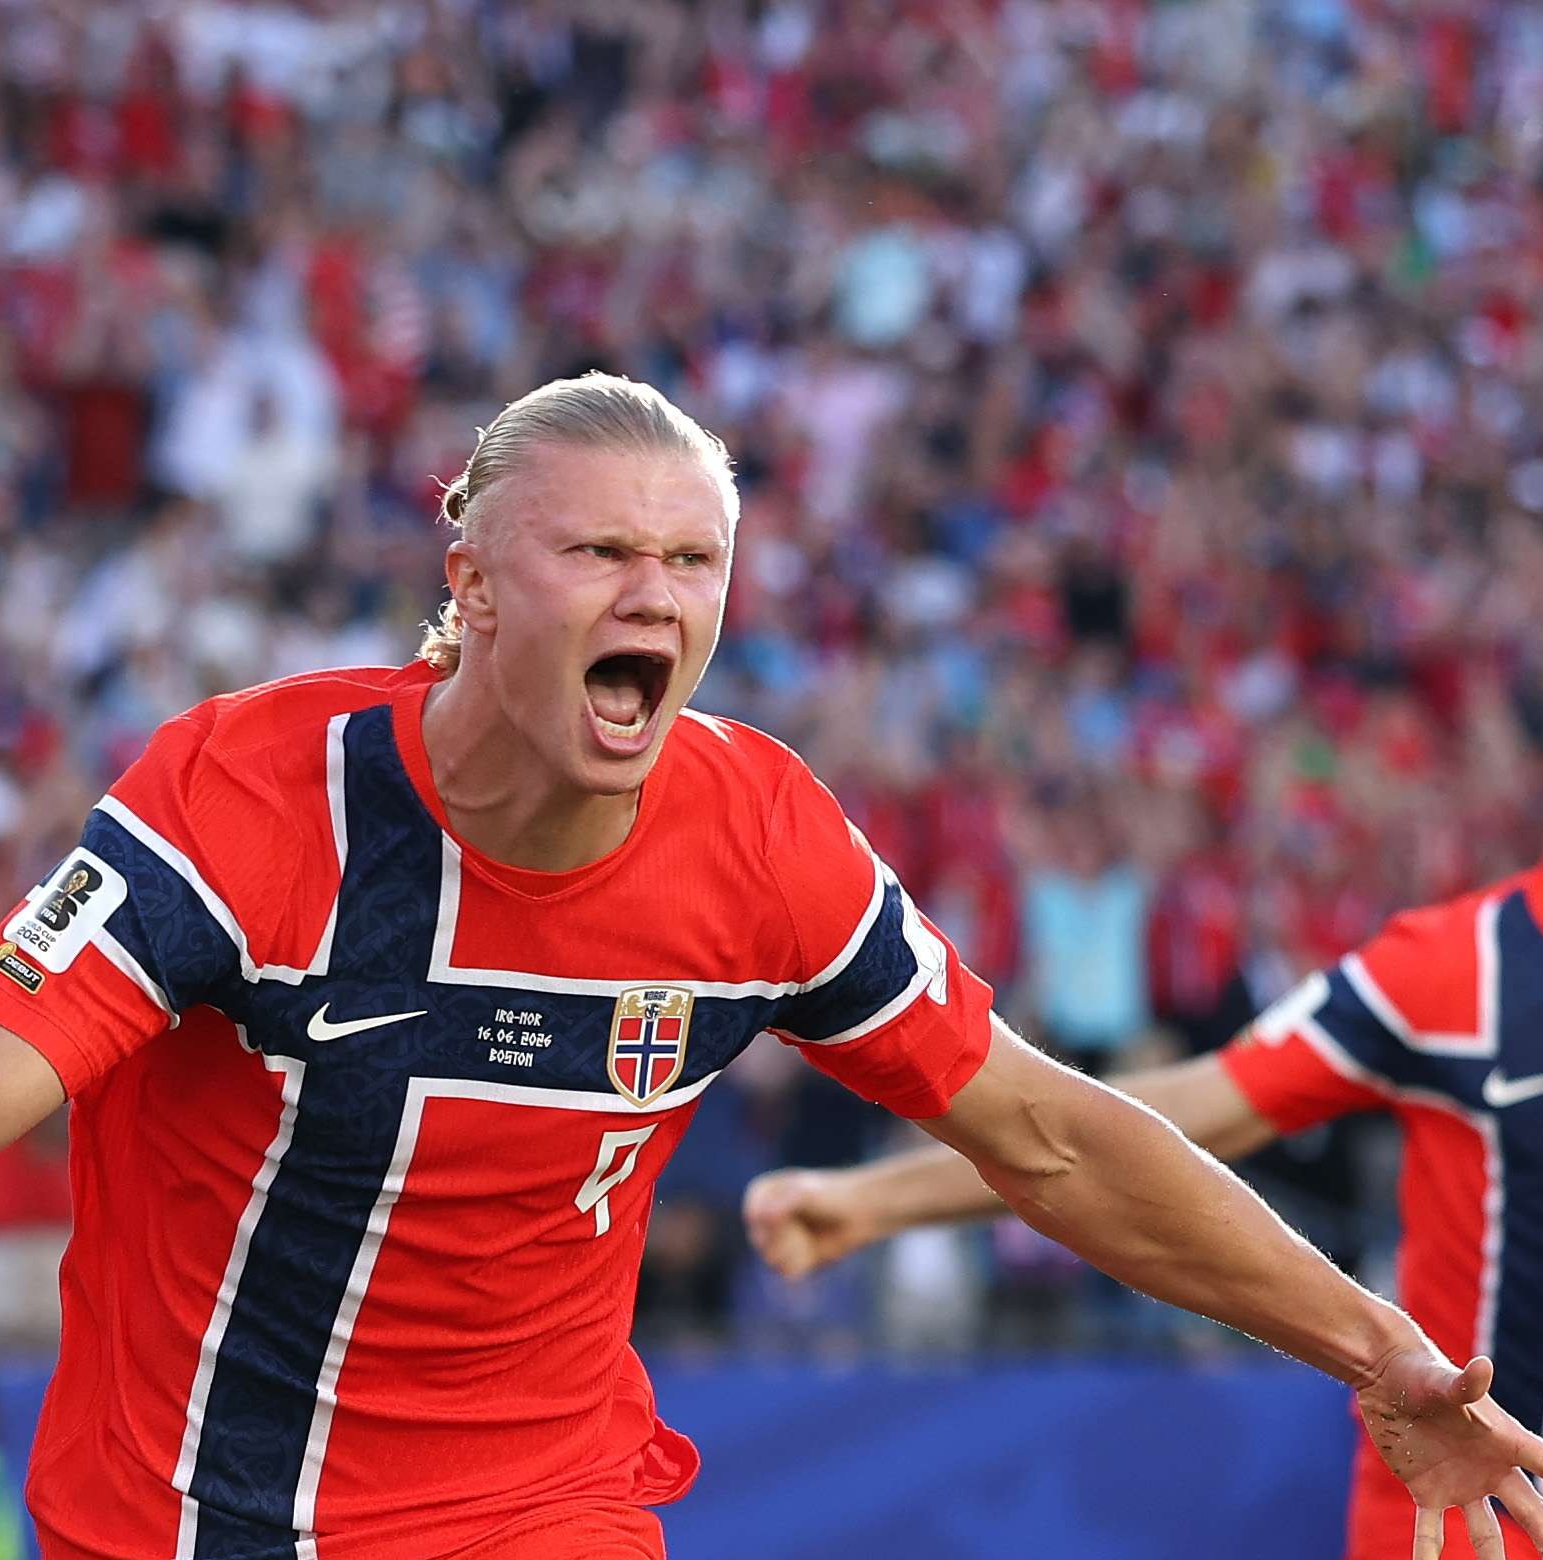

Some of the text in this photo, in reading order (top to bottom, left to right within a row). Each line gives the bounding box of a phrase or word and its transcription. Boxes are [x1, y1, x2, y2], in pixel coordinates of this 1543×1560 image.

[40, 907, 58, 924] FIFA
[16, 925, 51, 953] 2026
[41, 929, 57, 943] CUP
[4, 956, 40, 982] DEBUT
[494, 1008, 543, 1027] IRQ-NOR
[488, 1047, 534, 1068] BOSTON
[573, 1121, 659, 1239] 9
